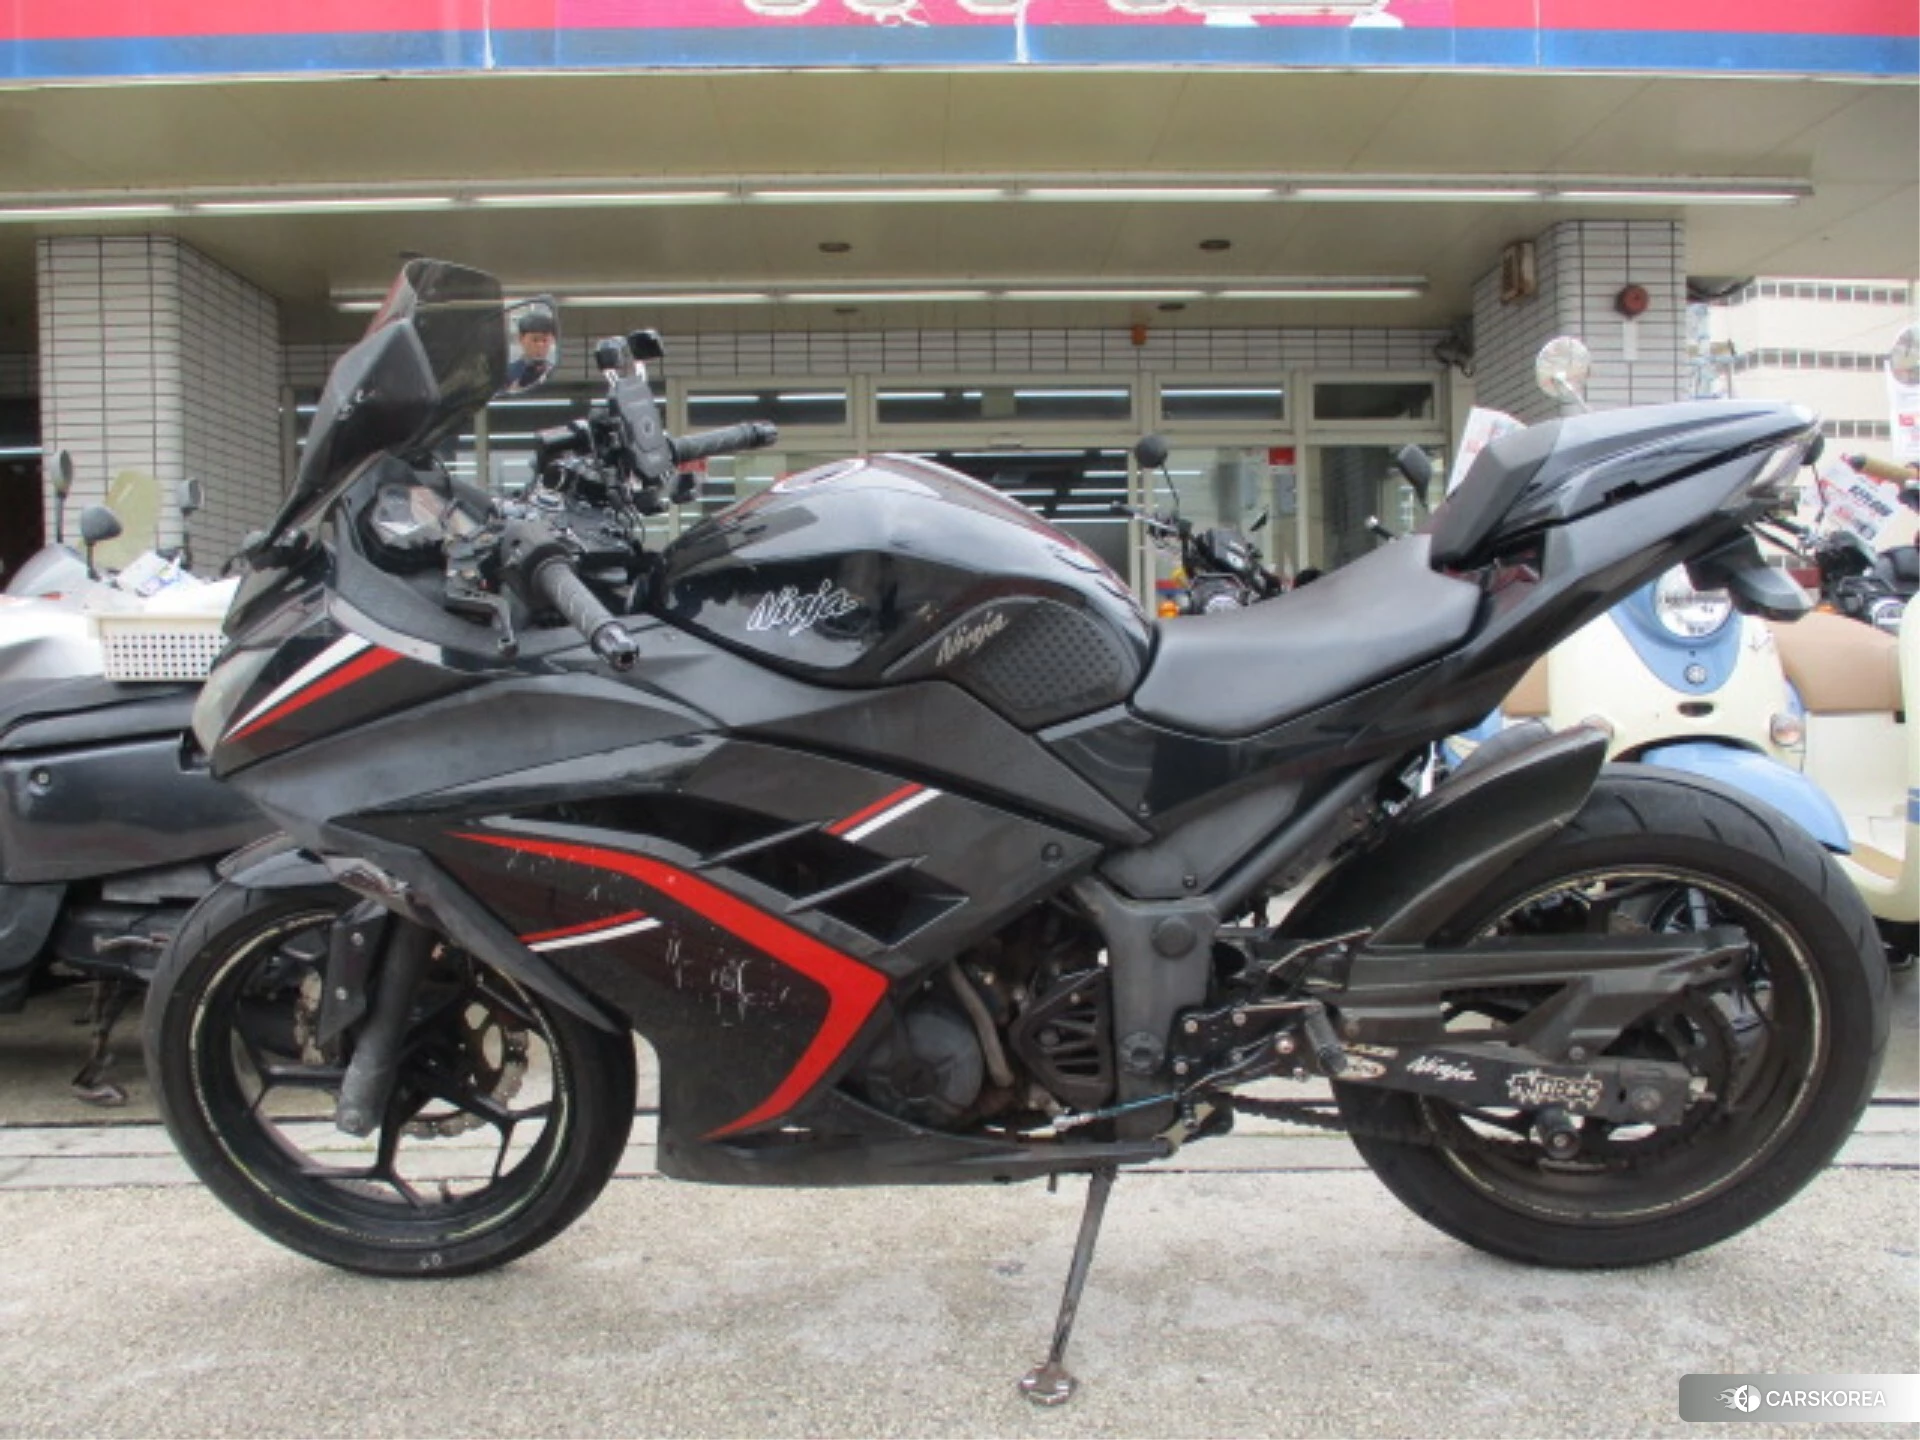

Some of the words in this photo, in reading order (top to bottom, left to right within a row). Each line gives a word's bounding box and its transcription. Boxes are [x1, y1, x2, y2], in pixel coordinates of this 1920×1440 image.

[747, 578, 859, 637] Ninja
[936, 610, 1010, 666] Ninja
[1406, 1055, 1477, 1081] Ninja
